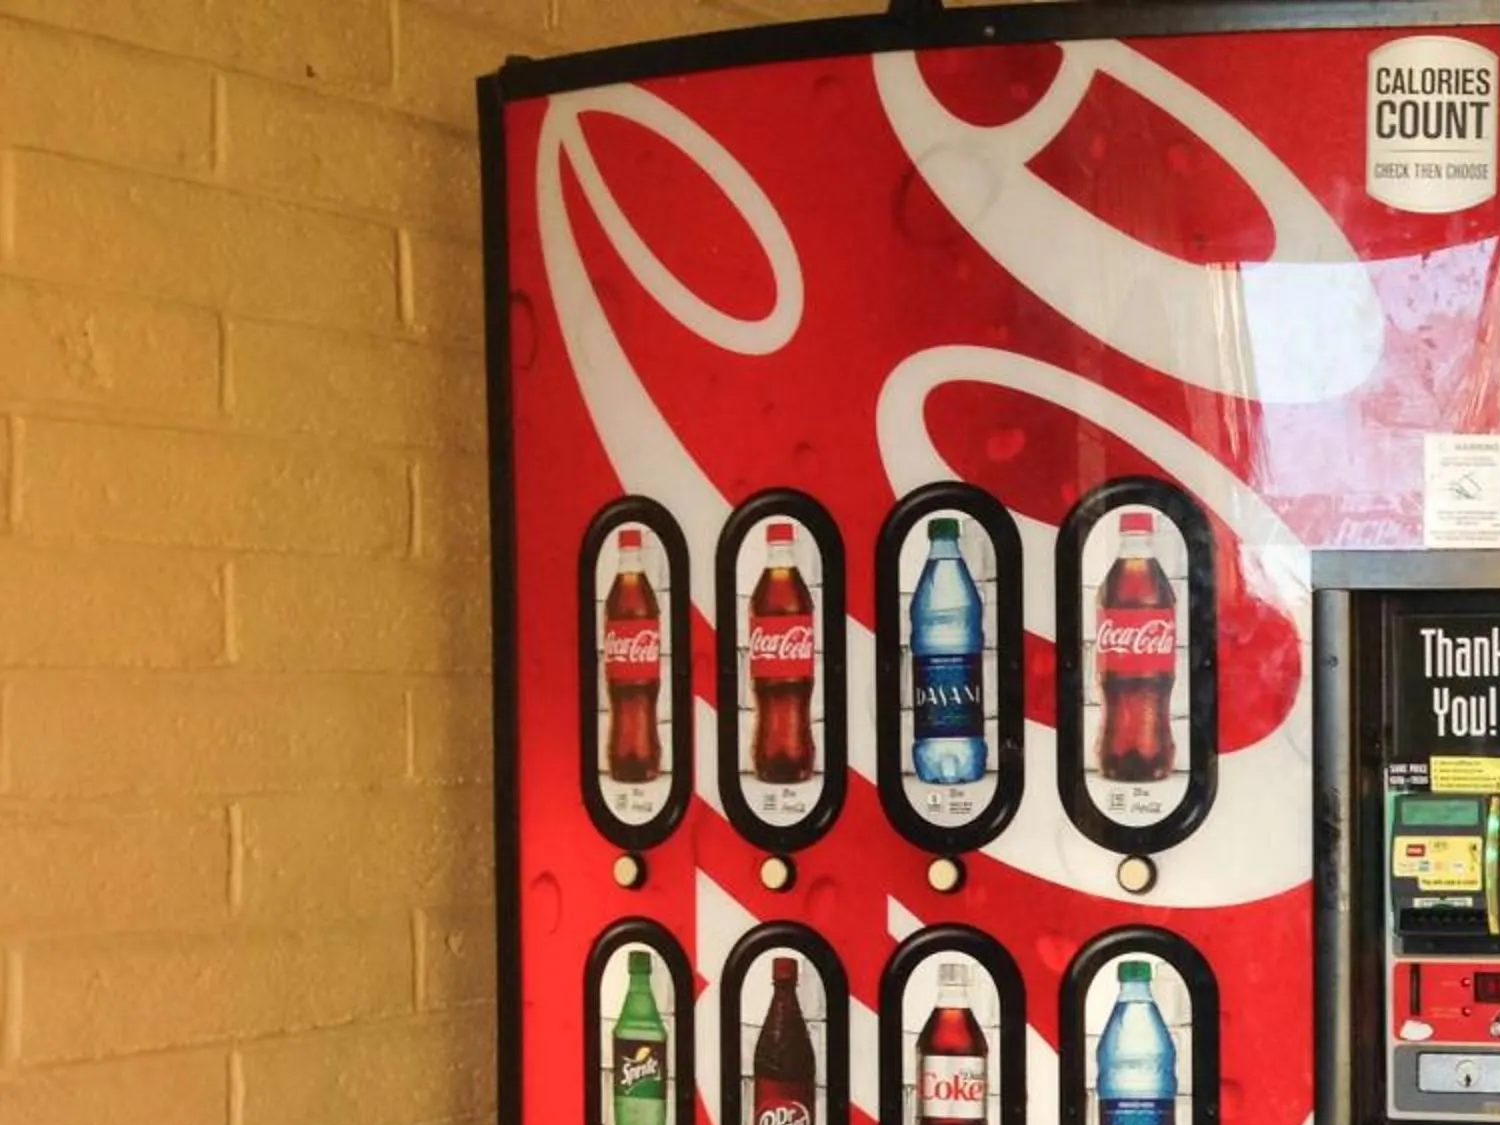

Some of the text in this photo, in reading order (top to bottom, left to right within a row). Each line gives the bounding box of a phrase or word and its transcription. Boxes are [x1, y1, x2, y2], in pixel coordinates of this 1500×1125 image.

[1375, 67, 1491, 95] CALORIES
[1375, 100, 1491, 139] COUNT
[1374, 162, 1489, 180] CHECK THEN CHOOSE
[1098, 619, 1175, 654] Coca-Cola
[1432, 686, 1497, 737] You!
[918, 1072, 985, 1101] Coke
[776, 1107, 797, 1125] Dr
